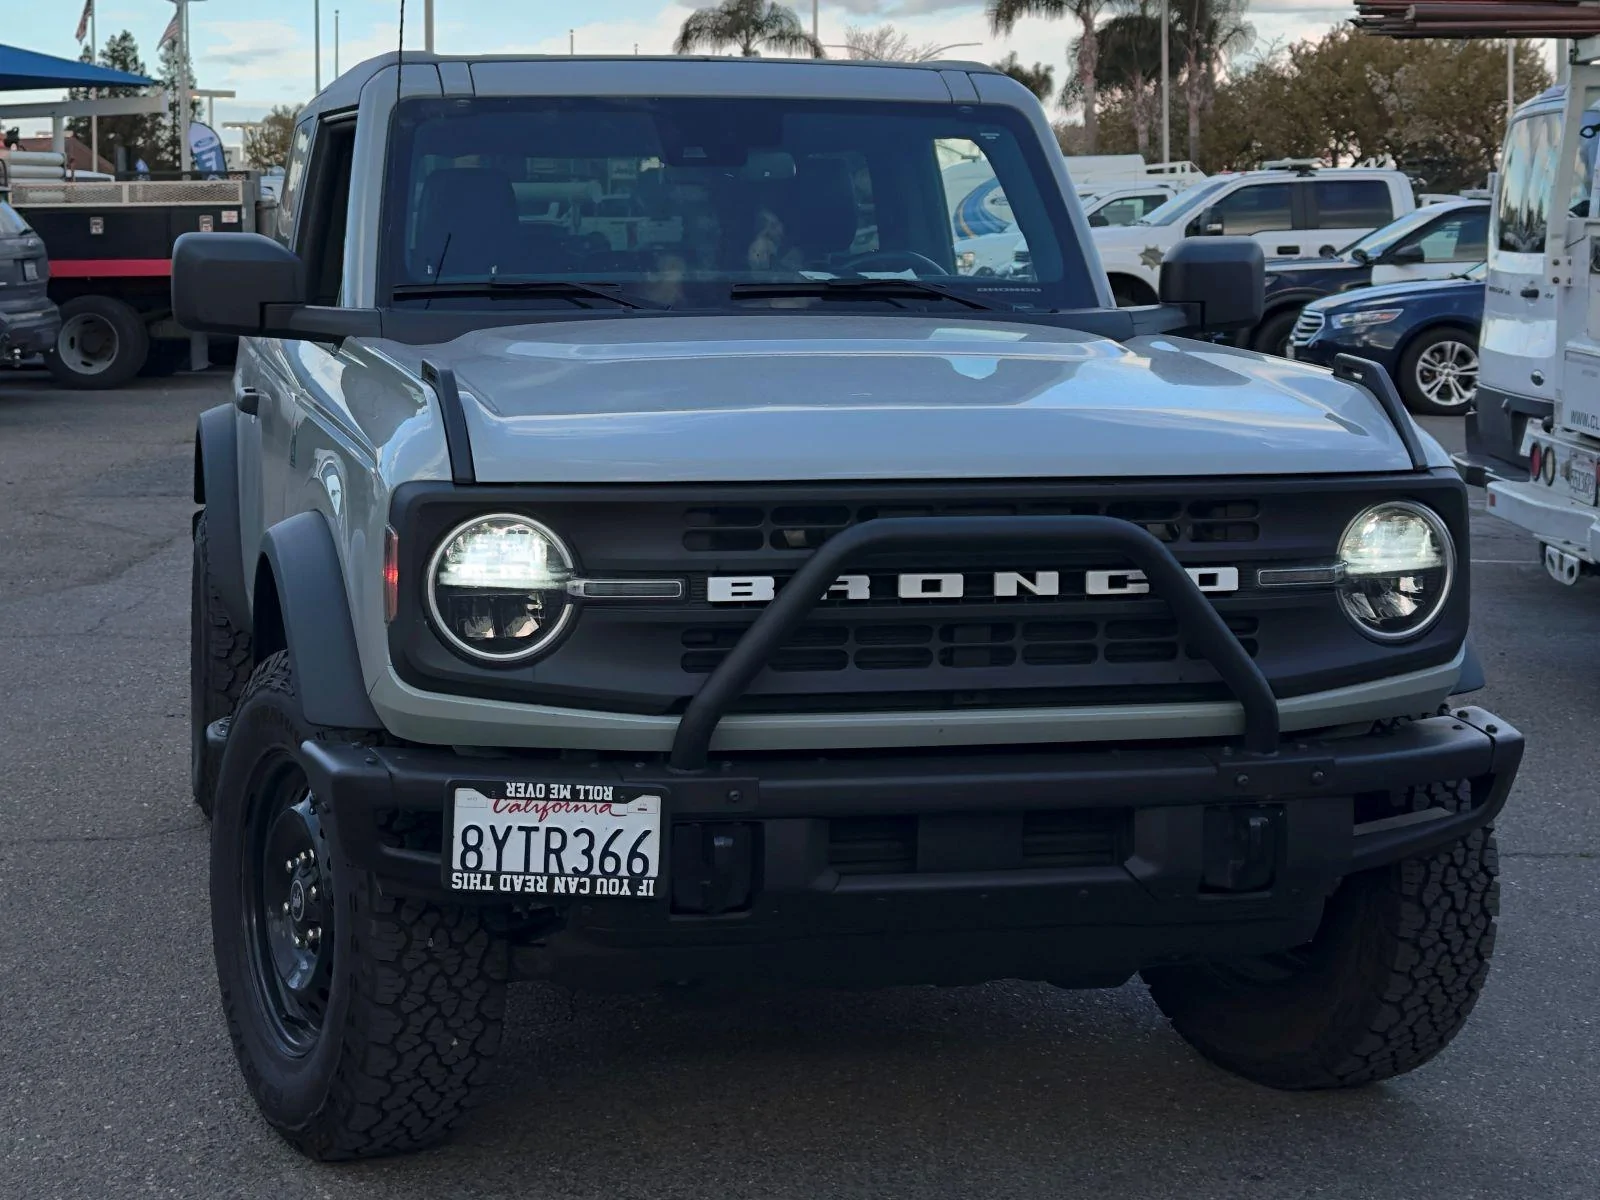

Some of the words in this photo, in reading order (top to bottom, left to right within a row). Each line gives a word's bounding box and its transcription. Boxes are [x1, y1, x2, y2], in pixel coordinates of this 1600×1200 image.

[707, 567, 1239, 600] BRONCO
[505, 781, 546, 799] OVER
[549, 783, 571, 799] ME
[575, 784, 614, 801] ROLL
[492, 798, 627, 823] California
[459, 824, 652, 877] 8YTR366
[451, 872, 494, 891] THIS
[500, 875, 548, 893] READ
[553, 876, 591, 894] CAN
[596, 878, 631, 895] YOU
[637, 879, 655, 897] IF
